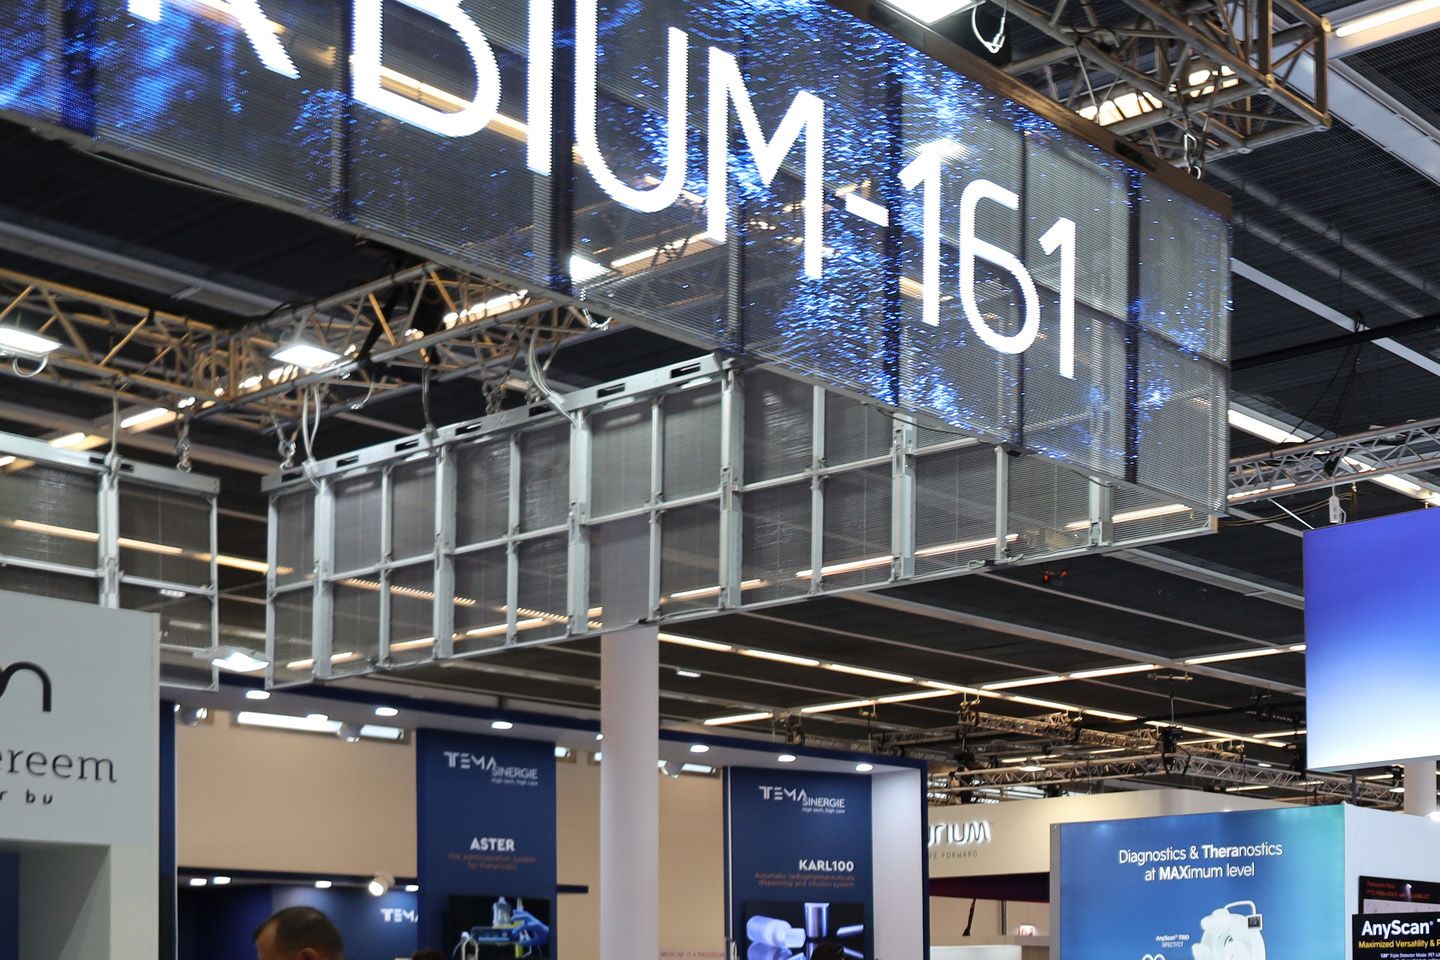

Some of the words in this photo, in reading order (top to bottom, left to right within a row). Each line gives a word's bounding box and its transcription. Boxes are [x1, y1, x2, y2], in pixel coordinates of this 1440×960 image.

[128, 0, 1077, 379] BIUM-161
[0, 749, 117, 783] reem
[443, 751, 497, 771] TEMA
[758, 786, 808, 802] TEMA
[802, 797, 846, 808] SINERGIE
[470, 837, 516, 852] ASTER
[1119, 847, 1187, 866] Diagnostics
[1190, 846, 1200, 860] &
[1202, 842, 1283, 860] Theranostics
[799, 859, 855, 872] KARL100
[1144, 867, 1156, 882] at
[1159, 864, 1223, 881] MAXimum
[1226, 862, 1255, 878] level
[1358, 940, 1395, 949] Maximized
[1396, 940, 1429, 949] Versatility
